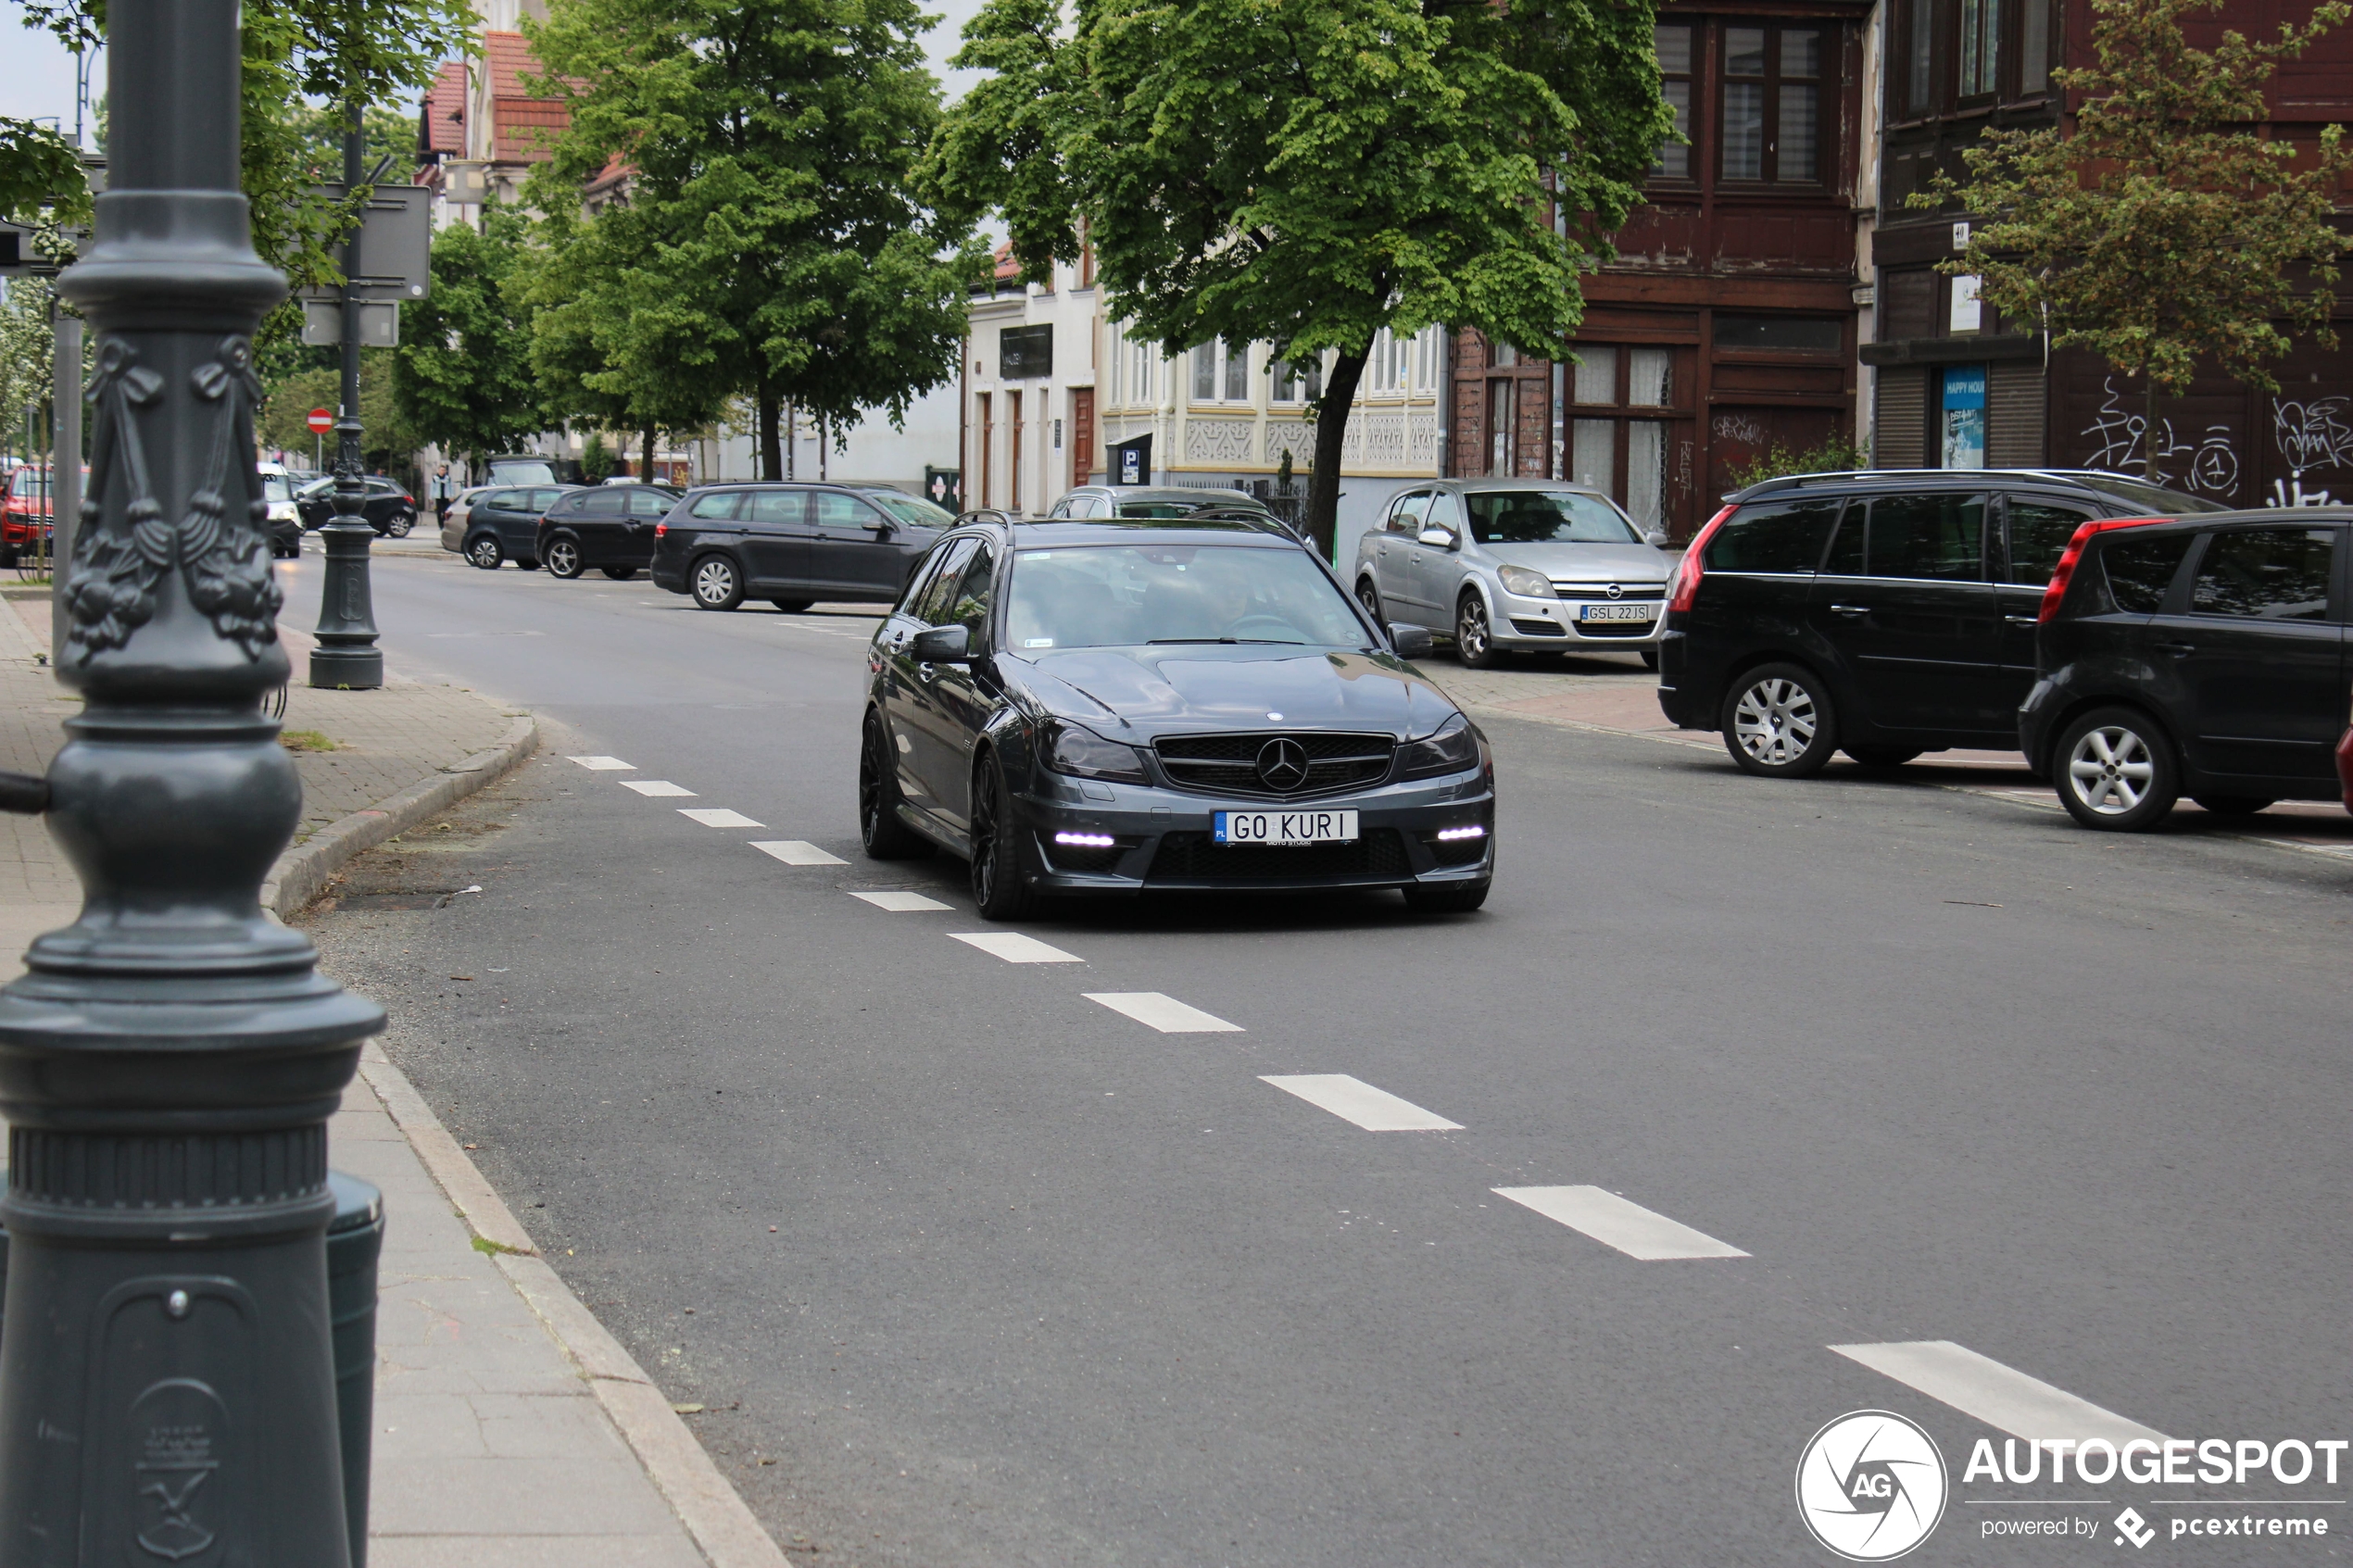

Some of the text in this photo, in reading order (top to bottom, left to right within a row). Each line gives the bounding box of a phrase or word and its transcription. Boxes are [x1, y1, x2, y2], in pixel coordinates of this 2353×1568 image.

[1946, 382, 1968, 395] HAPPY
[1126, 451, 1137, 465] P
[1590, 608, 1614, 619] GSL
[1618, 608, 1645, 619] 22JS
[1215, 830, 1226, 838] PL
